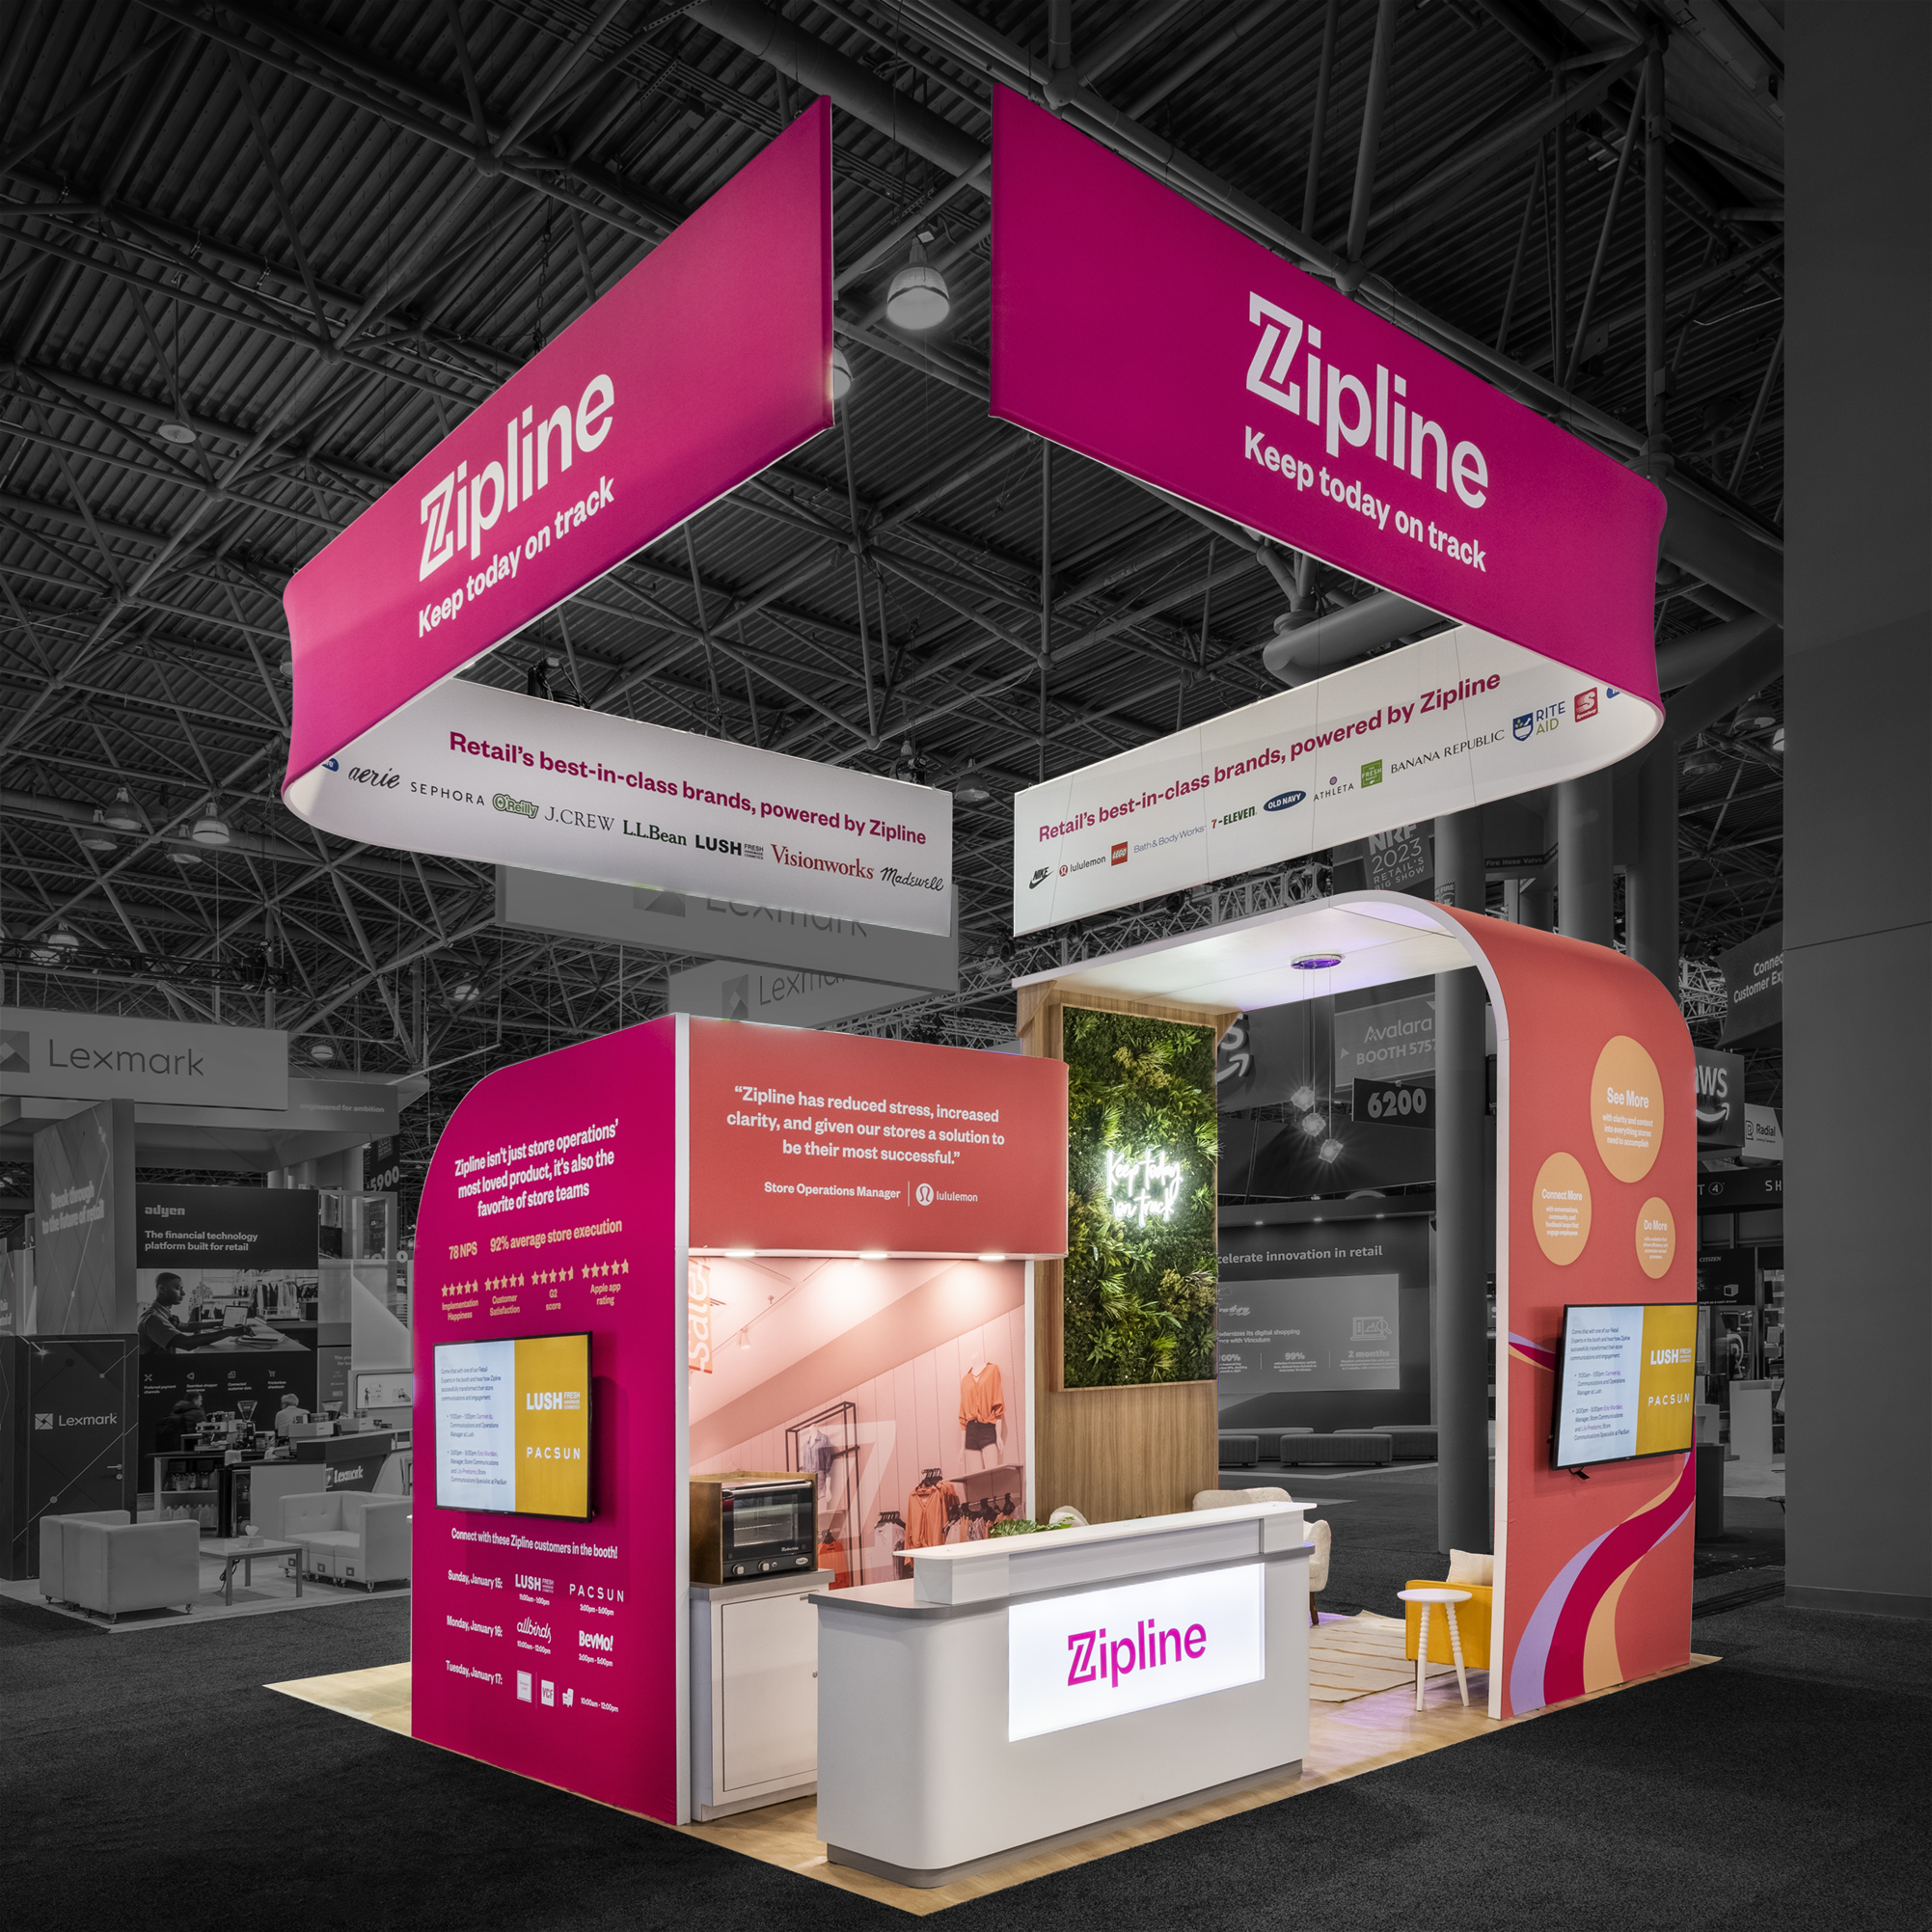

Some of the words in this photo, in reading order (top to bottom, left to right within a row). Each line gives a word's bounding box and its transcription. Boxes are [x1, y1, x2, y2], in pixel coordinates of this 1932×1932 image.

[1246, 291, 1488, 508] Zipline
[420, 374, 614, 582] Zipline
[1244, 425, 1314, 492] Keep
[1320, 467, 1390, 531] today
[1395, 510, 1423, 542] on
[1429, 521, 1486, 573] track
[419, 588, 463, 638] Keep
[466, 545, 521, 601] today
[525, 525, 551, 559] on
[554, 476, 614, 539] track
[1537, 700, 1565, 721] RITE
[1536, 718, 1559, 735] AID
[1039, 810, 1095, 842] Retail’s
[1099, 774, 1210, 823] best-in-class
[1213, 747, 1287, 784] brands,
[1291, 710, 1382, 761] powered
[1387, 702, 1415, 726] by
[1420, 674, 1501, 715] Zipline
[1390, 750, 1441, 775] BANANA
[1444, 730, 1505, 758] REPUBLIC
[347, 766, 400, 790] aerie
[449, 730, 534, 767] Retail’s
[539, 750, 678, 796] best-in-class
[682, 780, 756, 815] brands,
[760, 801, 840, 829] powered
[844, 813, 866, 836] by
[869, 819, 926, 845] Zipline
[410, 781, 485, 806] SEPHORA
[1267, 797, 1282, 809] OLD
[1282, 791, 1302, 806] NAVY
[1313, 782, 1354, 802] ATHLETA
[544, 806, 615, 831] J.CREW
[622, 819, 688, 846] L.L.Bean
[695, 834, 742, 856] LUSH
[1133, 840, 1152, 853] Bath
[1152, 839, 1158, 848] &
[1158, 832, 1179, 846] Body
[1179, 824, 1205, 840] Works
[770, 843, 875, 880] Visionworks
[1070, 855, 1106, 872] lululemon
[1372, 836, 1422, 875] 2023
[879, 866, 944, 891] Madewell
[1032, 866, 1049, 881] NIKE
[1374, 857, 1425, 884] RETAIL'S
[1374, 879, 1392, 891] BIG
[1396, 865, 1425, 884] SHOW
[1733, 976, 1770, 1003] Customer
[1364, 1018, 1432, 1043] Avalara
[49, 1039, 204, 1077] Lexmark
[1356, 1044, 1406, 1065] BOOTH
[300, 1102, 340, 1111] engineered
[734, 1085, 796, 1105] “Zipline
[798, 1091, 825, 1108] has
[828, 1096, 886, 1113] reduced
[888, 1102, 934, 1120] stress,
[936, 1104, 999, 1123] increased
[1368, 1088, 1427, 1118] 6200
[1607, 1086, 1625, 1105] See
[1625, 1090, 1649, 1109] More
[726, 1111, 780, 1131] clarity,
[783, 1117, 812, 1131] and
[814, 1118, 854, 1135] given
[857, 1123, 881, 1136] our
[883, 1125, 926, 1140] stores
[928, 1130, 937, 1140] a
[939, 1129, 990, 1145] solution
[992, 1132, 1005, 1145] to
[1756, 1123, 1776, 1136] Radial
[454, 1156, 485, 1177] Zipline
[486, 1146, 507, 1166] isn't
[507, 1143, 527, 1166] just
[528, 1138, 555, 1157] store
[782, 1139, 802, 1155] be
[804, 1141, 839, 1156] their
[842, 1146, 879, 1159] most
[881, 1150, 960, 1164] successful.”
[370, 1165, 399, 1192] 5900
[458, 1182, 481, 1198] most
[482, 1170, 508, 1192] loved
[509, 1164, 553, 1189] product,
[554, 1157, 570, 1177] it's
[571, 1153, 593, 1171] also
[595, 1148, 614, 1166] the
[477, 1195, 514, 1217] favorite
[516, 1190, 528, 1210] of
[528, 1188, 555, 1207] store
[556, 1183, 589, 1202] teams
[764, 1182, 795, 1194] Store
[797, 1183, 855, 1198] Operations
[857, 1186, 901, 1201] Manager
[936, 1190, 978, 1203] lululemon
[1541, 1188, 1567, 1200] Connect
[1567, 1189, 1583, 1201] More
[145, 1205, 186, 1217] adyen
[145, 1230, 163, 1239] The
[165, 1231, 204, 1240] financial
[206, 1232, 259, 1242] technology
[1644, 1219, 1652, 1231] Do
[1652, 1219, 1668, 1231] More
[145, 1241, 185, 1251] platform
[187, 1241, 208, 1250] built
[209, 1242, 224, 1251] for
[225, 1242, 248, 1251] retail
[449, 1245, 459, 1260] 78
[460, 1240, 477, 1257] NPS
[490, 1235, 509, 1252] 92%
[510, 1232, 546, 1249] average
[547, 1227, 572, 1243] store
[573, 1218, 622, 1238] execution
[1266, 1248, 1333, 1262] innovation
[1335, 1248, 1347, 1258] in
[1349, 1245, 1382, 1257] retail
[526, 1392, 562, 1410] LUSH
[58, 1412, 117, 1428] Lexmark
[527, 1447, 581, 1459] PACSUN
[334, 1465, 364, 1483] Lexmark
[451, 1527, 477, 1541] Connect
[477, 1531, 491, 1543] with
[492, 1533, 510, 1546] these
[510, 1535, 533, 1550] Zipline
[534, 1538, 571, 1555] customers
[572, 1541, 580, 1555] in
[580, 1543, 592, 1556] the
[593, 1544, 618, 1559] booth!
[448, 1569, 470, 1585] Sunday,
[471, 1573, 494, 1590] January
[515, 1573, 542, 1592] LUSH
[569, 1584, 624, 1602] PACSUN
[447, 1615, 470, 1632] Monday,
[471, 1620, 494, 1638] January
[517, 1617, 552, 1644] allbirds
[579, 1629, 613, 1651] BevMo!
[1067, 1619, 1207, 1688] Zipline
[446, 1660, 470, 1677] Tuesday,
[471, 1667, 495, 1685] January
